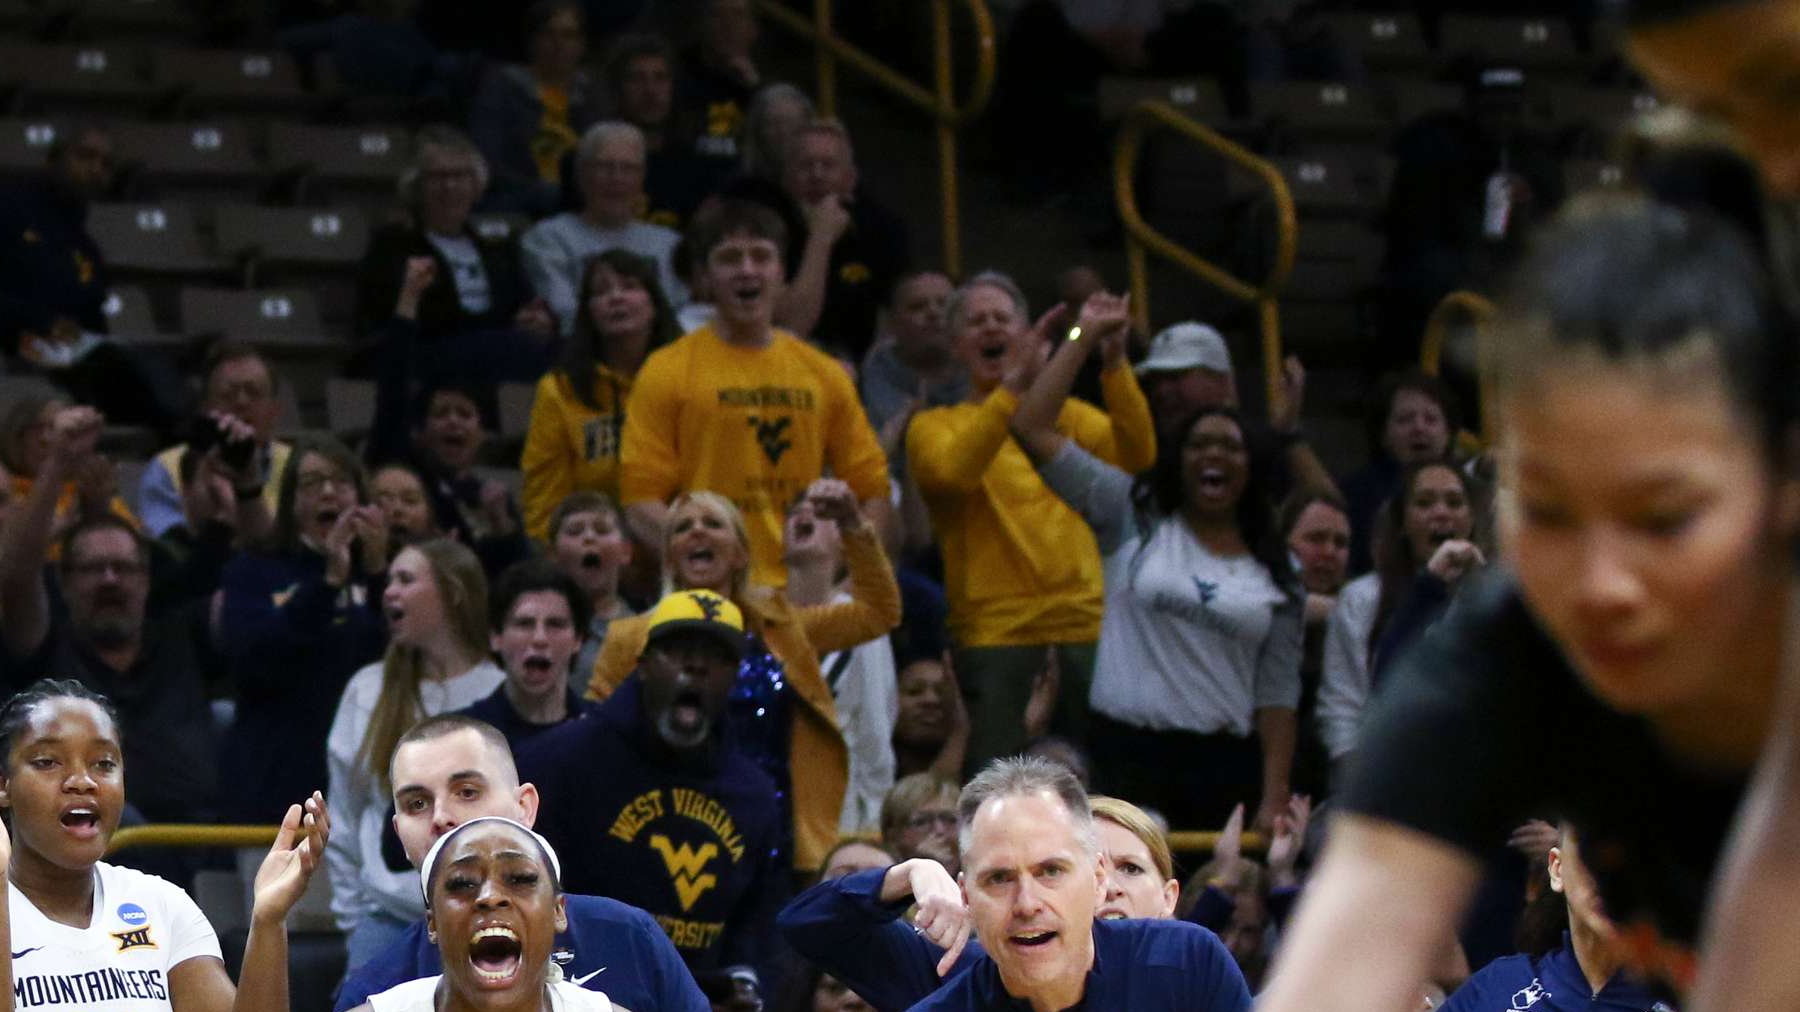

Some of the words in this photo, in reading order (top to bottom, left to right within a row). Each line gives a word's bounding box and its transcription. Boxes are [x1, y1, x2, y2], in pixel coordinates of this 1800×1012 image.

[608, 789, 664, 843] WEST
[671, 787, 746, 864] VIRGINIA
[12, 966, 166, 1009] MOUNTAINEERS
